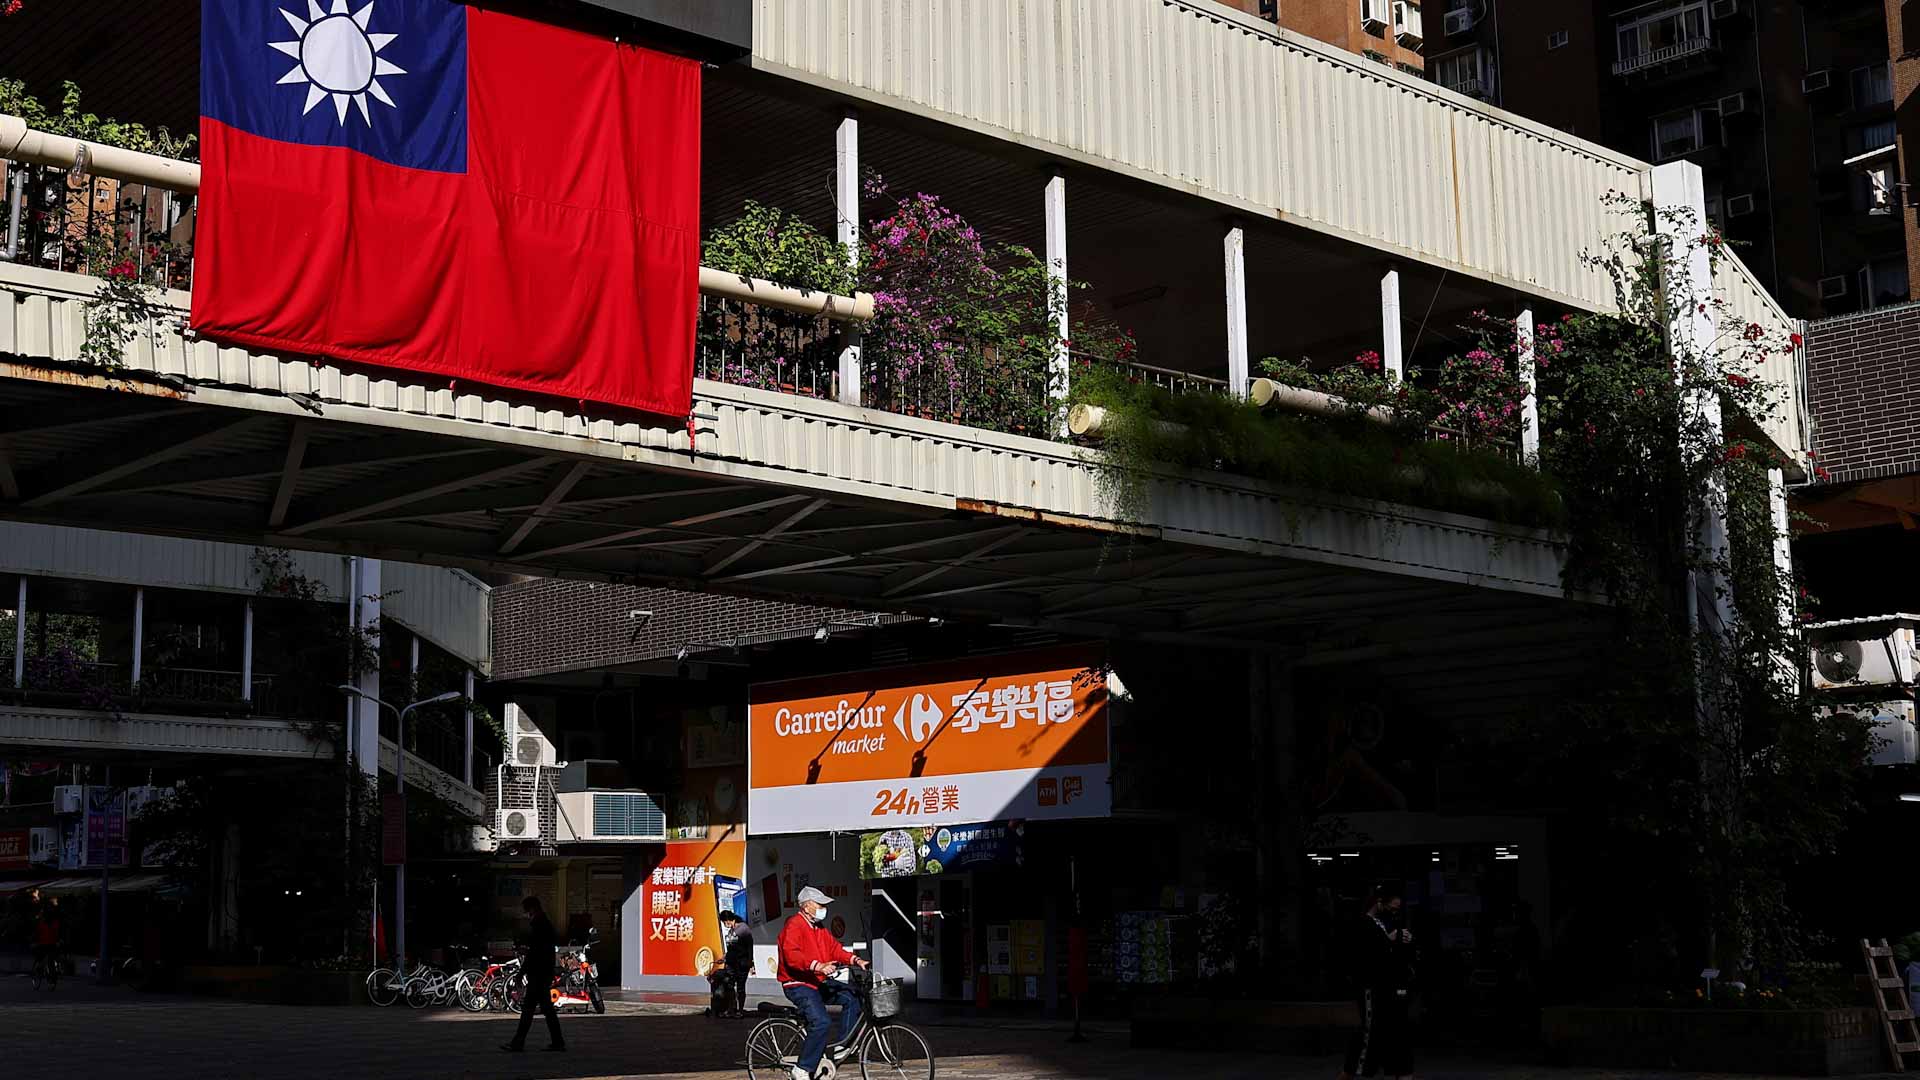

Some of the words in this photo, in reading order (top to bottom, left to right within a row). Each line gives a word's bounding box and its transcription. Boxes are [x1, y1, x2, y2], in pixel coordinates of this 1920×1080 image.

[775, 700, 886, 737] Carrefour
[951, 680, 1075, 734] 家樂福
[832, 732, 886, 755] market
[1039, 786, 1056, 799] ATM
[652, 866, 717, 886] 家樂福好康卡
[651, 890, 682, 915] 賺點
[649, 916, 694, 941] 又省錢
